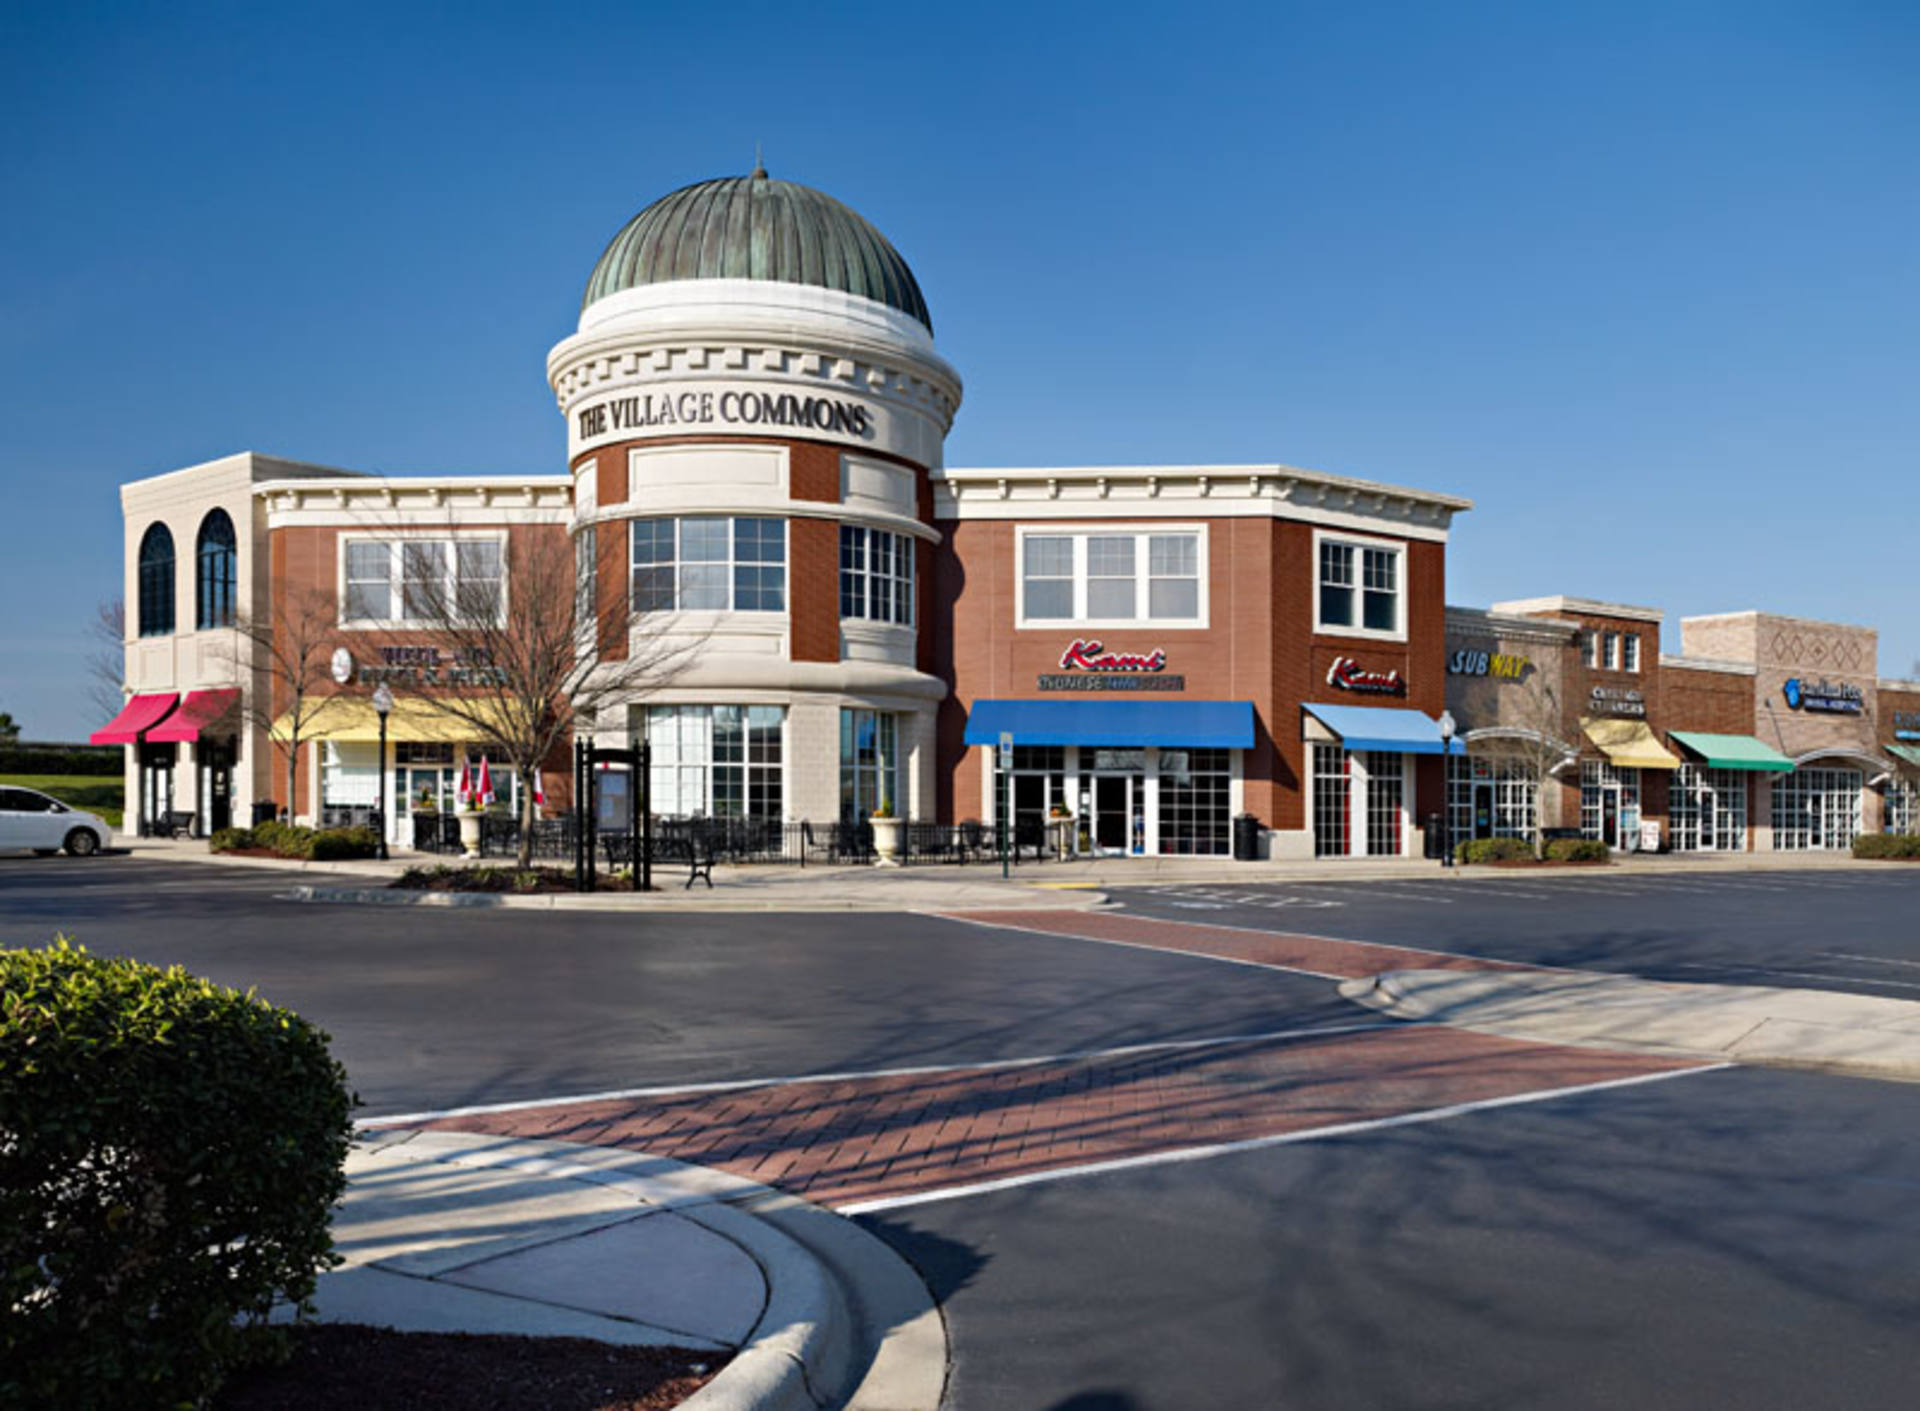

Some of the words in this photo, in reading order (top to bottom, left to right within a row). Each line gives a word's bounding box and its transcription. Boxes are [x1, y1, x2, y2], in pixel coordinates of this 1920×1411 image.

[579, 403, 607, 441] THE
[609, 391, 714, 429] VILLAGE
[720, 390, 867, 435] COMMONS
[1450, 650, 1525, 679] SUBWAY
